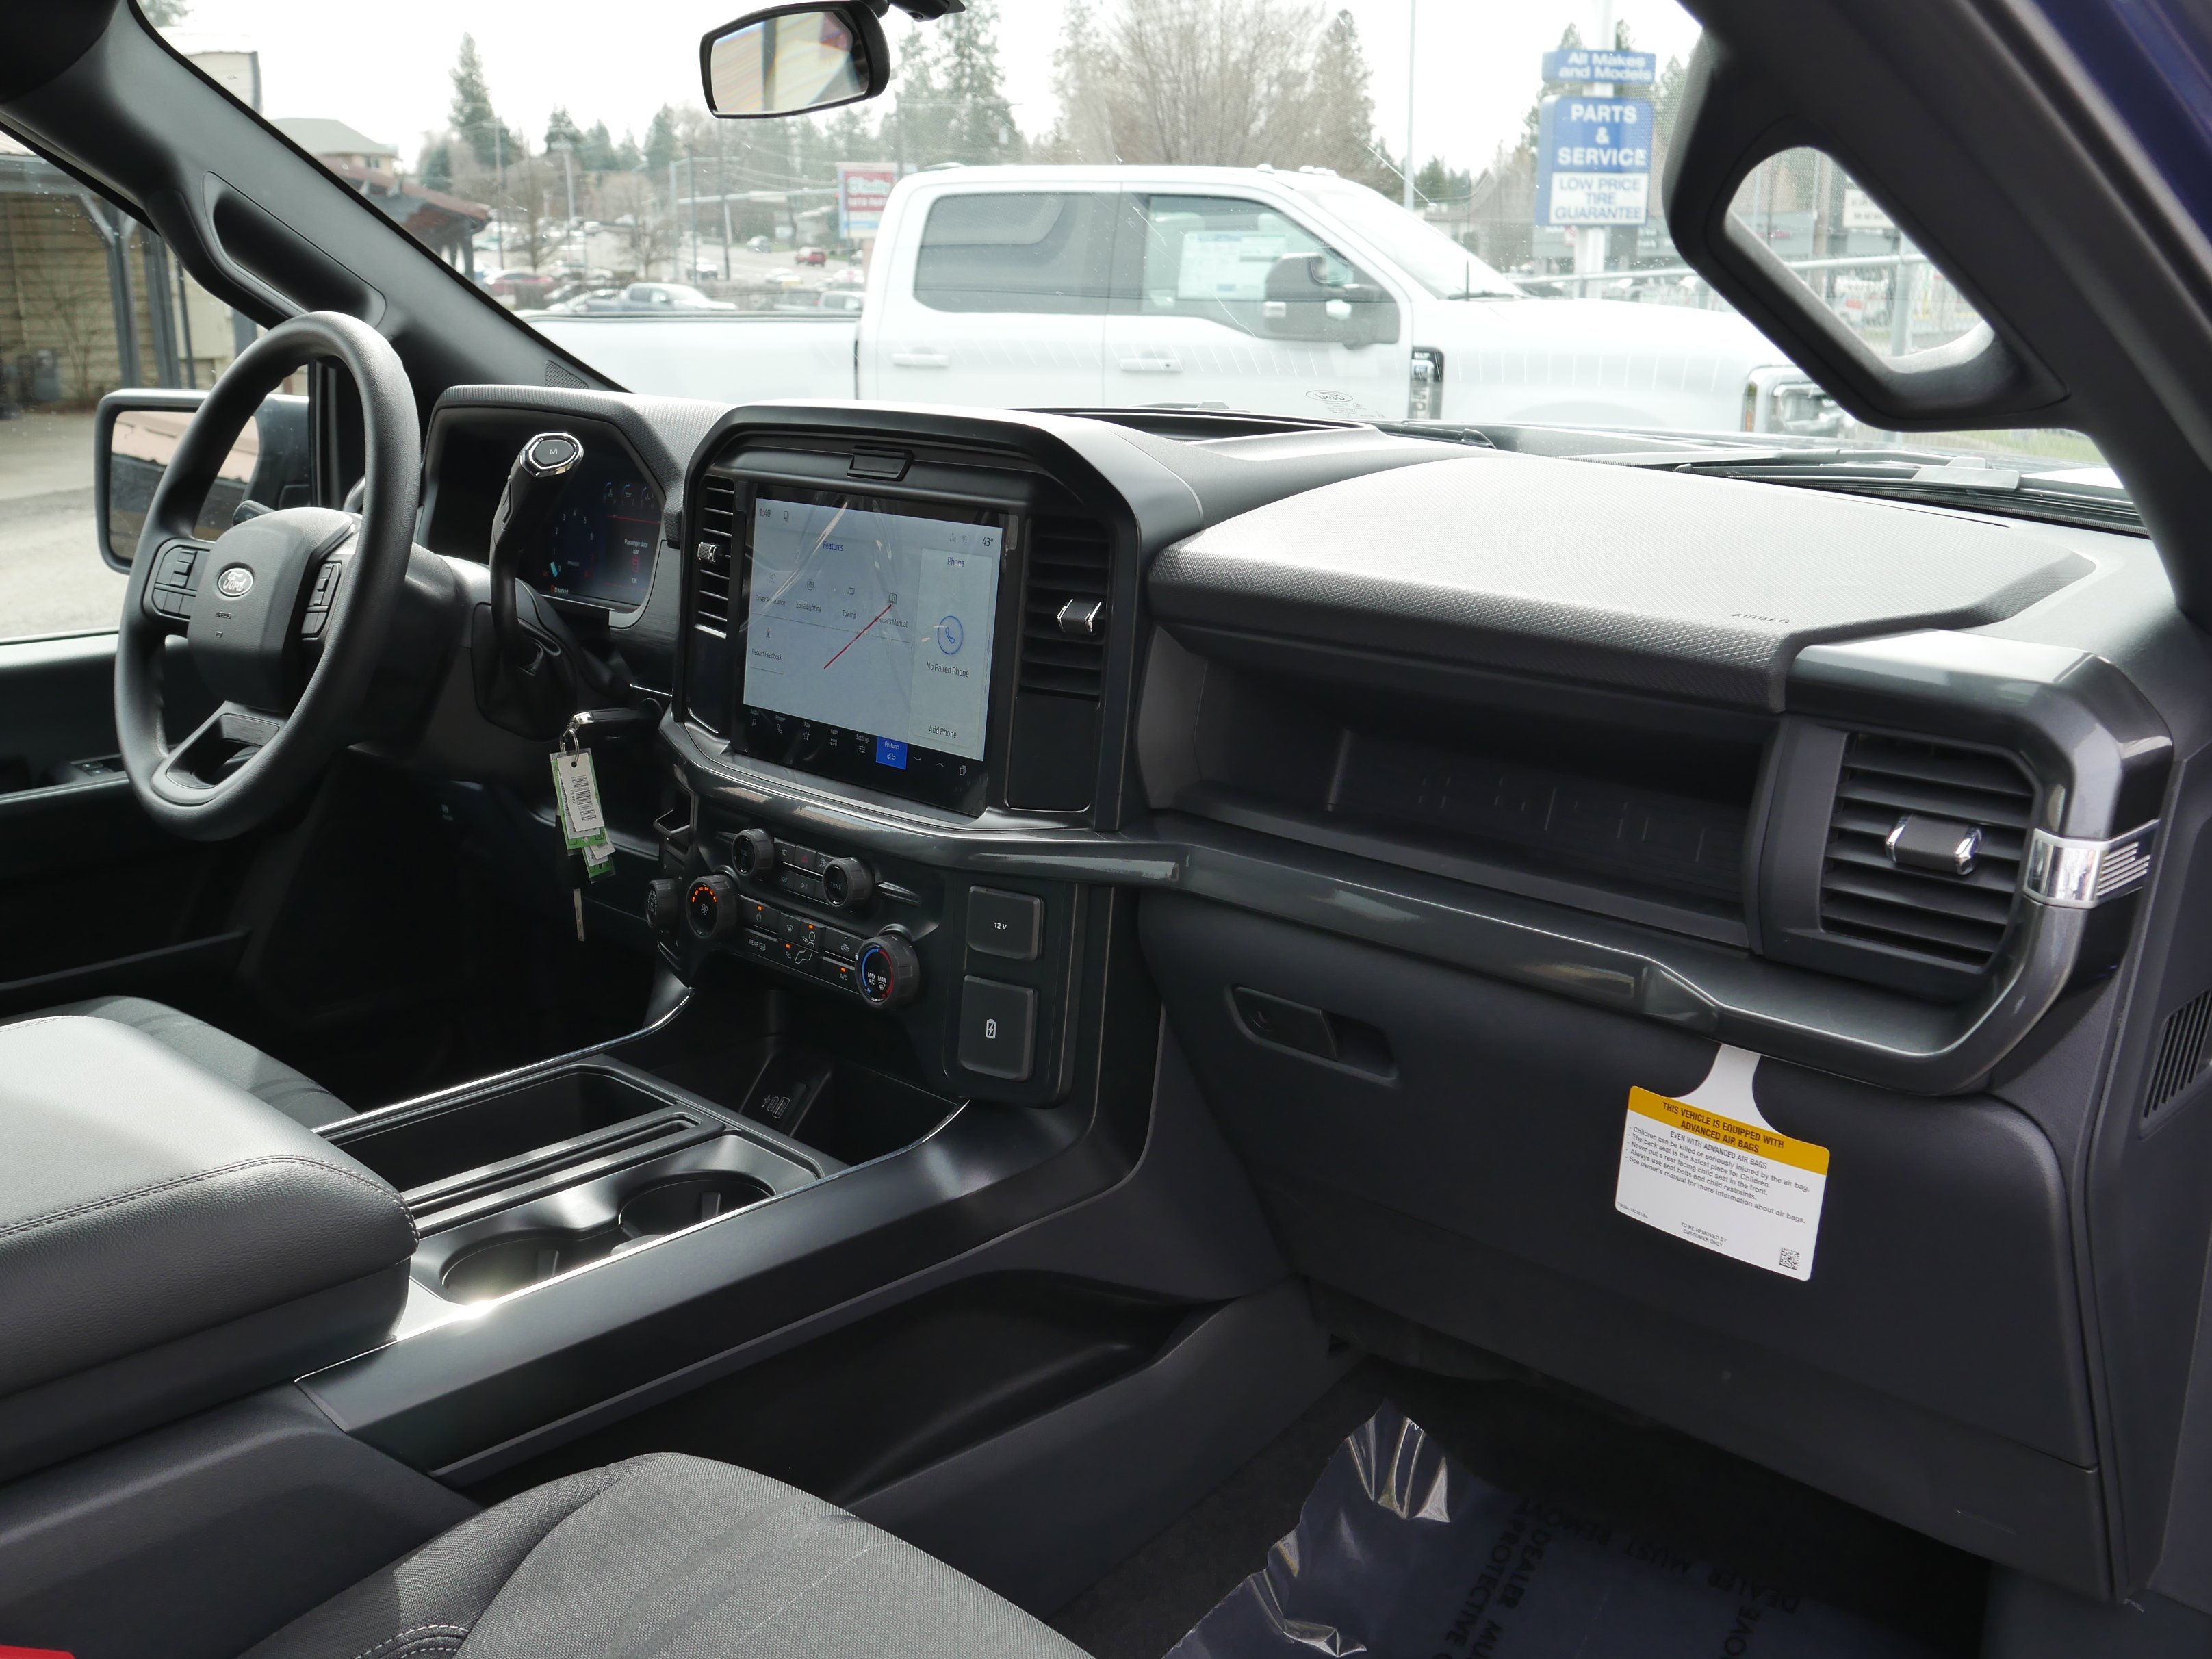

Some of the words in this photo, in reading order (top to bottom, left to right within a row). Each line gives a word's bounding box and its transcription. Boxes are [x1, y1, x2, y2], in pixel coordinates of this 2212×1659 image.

[1568, 52, 1588, 65] All
[1592, 53, 1646, 66] Makes
[1558, 66, 1590, 79] and
[1594, 66, 1652, 80] Models
[1571, 105, 1637, 123] PARTS
[1595, 127, 1610, 144] &
[1557, 147, 1646, 166] SERVICE
[1560, 178, 1593, 190] LOW
[1598, 178, 1640, 190] PRICE
[1586, 193, 1615, 205] TIRE
[1555, 207, 1641, 219] GUARANTEE
[760, 508, 771, 517] 1:40
[823, 541, 844, 552] Features
[947, 556, 965, 567] Phone
[756, 594, 767, 602] Driver
[843, 610, 857, 620] Towing
[1731, 613, 1790, 624] AIRBAG
[892, 619, 908, 628] Manual
[752, 648, 764, 656] Record
[764, 651, 782, 660] Feedback
[926, 661, 934, 671] No
[934, 663, 951, 674] Paired
[952, 667, 969, 678] Phone
[856, 734, 870, 743] Settings
[929, 725, 940, 734] Add
[940, 728, 957, 738] Phone
[884, 741, 899, 751] Features
[830, 881, 842, 890] TUNE
[839, 973, 848, 981] A/C
[877, 975, 886, 983] MAX
[1662, 1102, 1680, 1114] THIS
[1681, 1107, 1711, 1125] VEHICLE
[1712, 1119, 1721, 1128] IS
[1723, 1122, 1760, 1142] EQUIPPED
[1763, 1135, 1785, 1148] WITH
[1681, 1120, 1721, 1140] ADVANCED
[1723, 1135, 1736, 1145] AIR
[1738, 1140, 1759, 1153] BAGS
[1670, 1131, 1686, 1142] EVEN
[1687, 1137, 1703, 1148] WITH
[1703, 1143, 1736, 1159] ADVANCED
[1737, 1154, 1748, 1163] AIR
[1750, 1158, 1767, 1169] BAGS
[1632, 1133, 1643, 1142] The
[1644, 1138, 1658, 1148] back
[1659, 1145, 1671, 1153] seat
[1679, 1152, 1689, 1160] the
[1690, 1157, 1710, 1168] safest
[1710, 1163, 1728, 1174] place
[1740, 1173, 1771, 1188] Children.
[1633, 1126, 1657, 1140] Children
[1679, 1144, 1695, 1155] killed
[1705, 1154, 1734, 1168] seriously
[1736, 1163, 1759, 1176] injured
[1760, 1172, 1769, 1181] by
[1771, 1175, 1782, 1183] the
[1795, 1183, 1810, 1192] bag.
[1630, 1149, 1650, 1161] Always
[1663, 1162, 1676, 1171] seat
[1677, 1167, 1692, 1178] belts
[1693, 1173, 1706, 1182] and
[1706, 1178, 1723, 1188] child
[1723, 1185, 1757, 1200] restraints.
[1632, 1142, 1647, 1152] Never
[1648, 1149, 1658, 1157] put
[1664, 1155, 1676, 1163] rear
[1677, 1159, 1696, 1172] facing
[1697, 1167, 1713, 1176] child
[1714, 1173, 1728, 1181] seat
[1737, 1181, 1748, 1189] the
[1750, 1185, 1768, 1196] front.
[1630, 1156, 1640, 1165] See
[1641, 1162, 1663, 1174] owner's
[1664, 1171, 1686, 1183] manual
[1697, 1183, 1714, 1193] more
[1715, 1189, 1753, 1207] information
[1754, 1203, 1775, 1214] about
[1786, 1213, 1806, 1224] bags.
[1683, 1229, 1709, 1242] CUSTOMER
[1710, 1239, 1723, 1247] ONLY
[1696, 1227, 1719, 1240] REMOVED
[1622, 1539, 1693, 1576] MUST
[1497, 1527, 1552, 1608] DEALER
[1445, 1519, 1526, 1647] PROTECTIVE
[1708, 1568, 1801, 1615] DEALER
